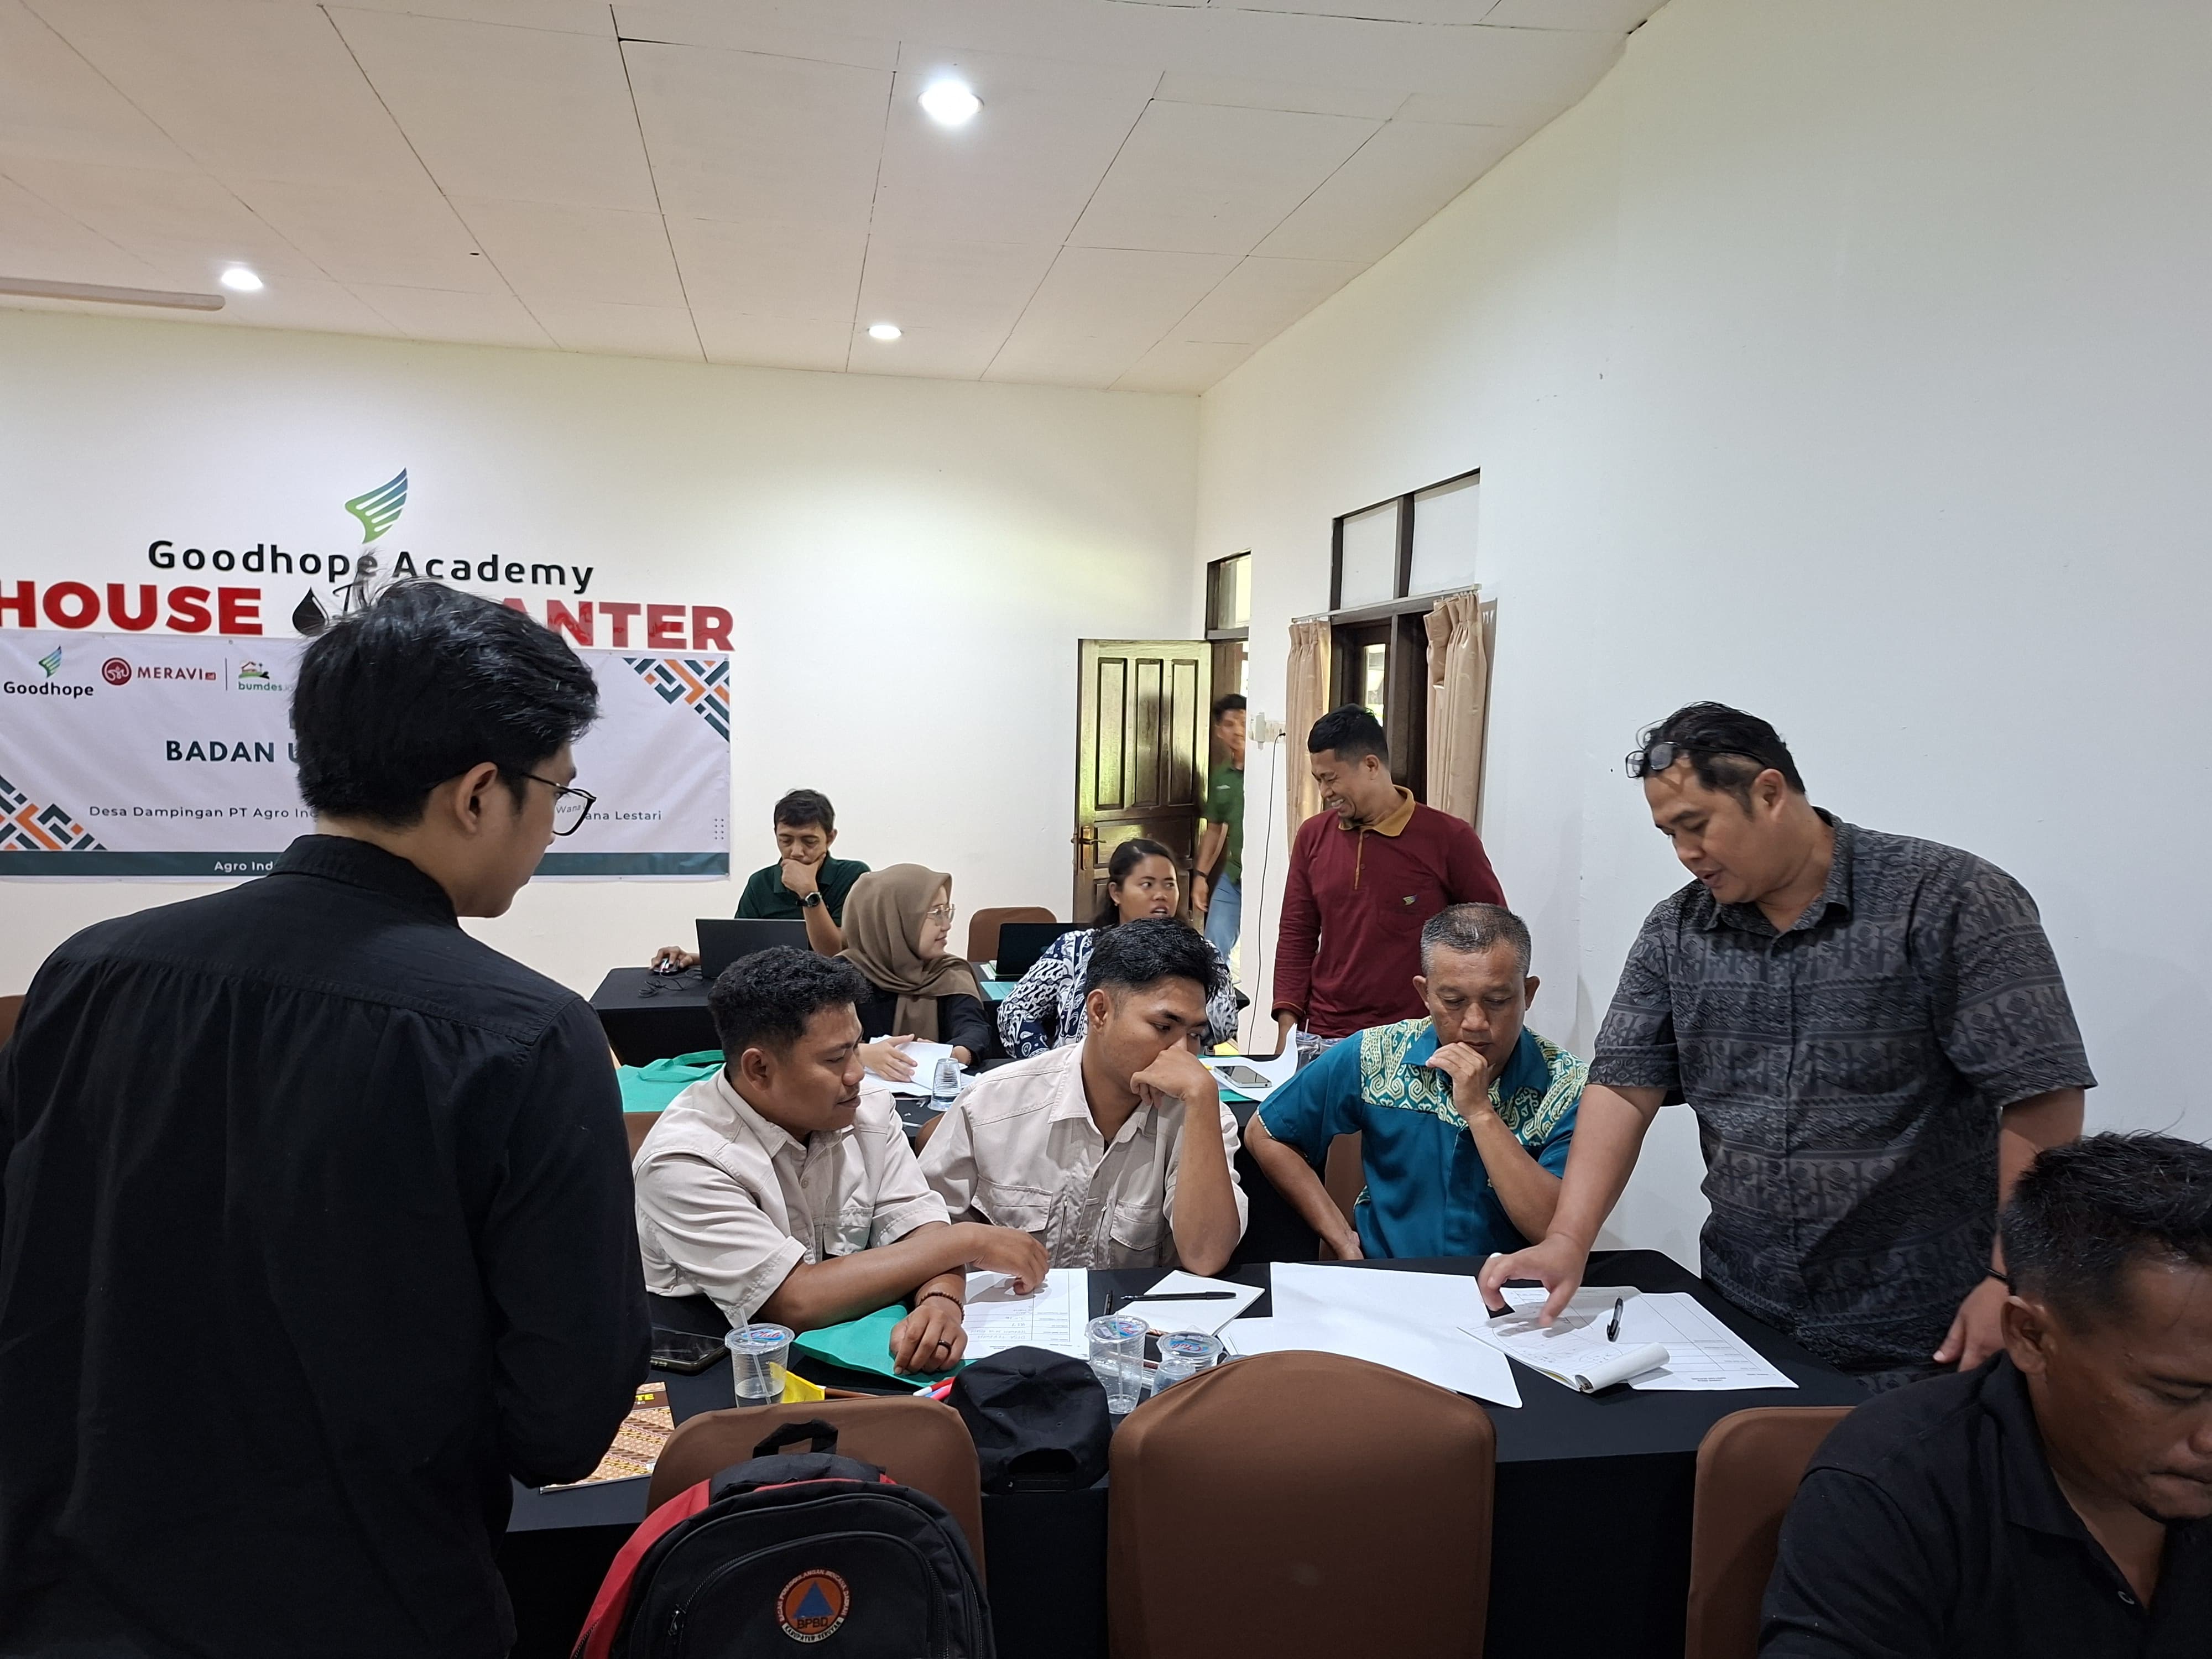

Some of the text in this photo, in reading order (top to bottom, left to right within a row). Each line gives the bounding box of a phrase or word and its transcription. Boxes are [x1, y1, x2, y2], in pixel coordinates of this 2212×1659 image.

[149, 540, 593, 594] Goodhope Academy
[0, 580, 263, 635] HOUSE
[137, 667, 202, 680] MERAVI
[3, 681, 93, 699] Goodhope
[166, 740, 274, 762] BADAN
[90, 806, 127, 816] Desa
[133, 807, 222, 820] Dampingan
[229, 807, 247, 817] PT
[253, 808, 289, 820] Agro
[615, 811, 661, 820] Lestari
[214, 861, 273, 873] Agro Ind
[1172, 1343, 1202, 1352] Club
[797, 1618, 828, 1629] BPBD
